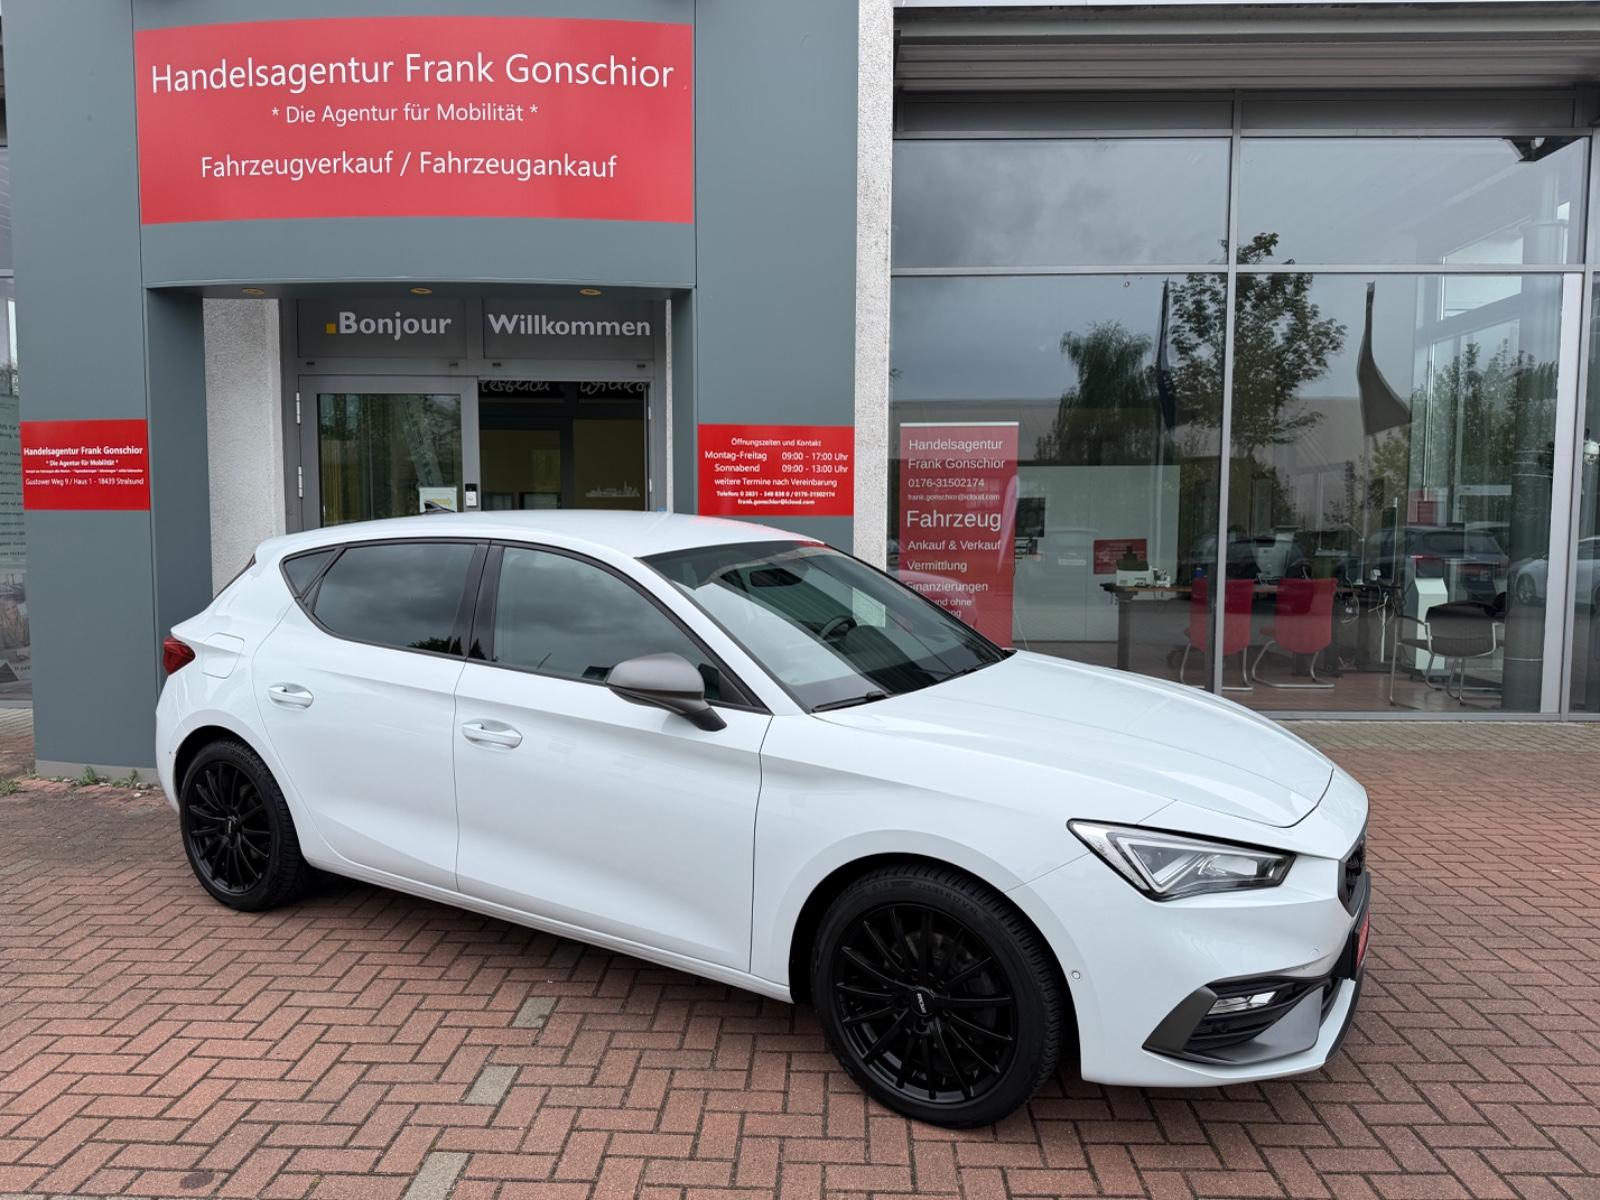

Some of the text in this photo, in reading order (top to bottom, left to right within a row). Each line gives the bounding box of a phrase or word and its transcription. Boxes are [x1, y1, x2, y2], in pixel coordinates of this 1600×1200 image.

[152, 52, 674, 94] Handelsagentur Frank Gonschior
[287, 104, 315, 123] Die
[321, 104, 397, 127] Agentur
[403, 102, 430, 122] für
[437, 103, 523, 122] Mobilität
[201, 151, 616, 181] Fahrzeugverkauf / Fahrzeugankauf
[339, 311, 651, 341] Bonjour Willkommen
[731, 437, 821, 448] Öffnungszeiten und Kontakt
[908, 439, 1004, 452] Handelsagentur
[24, 447, 79, 457] Handelsagentur
[81, 446, 101, 455] Frank
[103, 445, 143, 455] Gonschior
[704, 450, 767, 461] Montag-Freitag
[782, 452, 803, 460] 09:00
[812, 452, 833, 460] 17:00
[834, 452, 849, 461] Uhr
[714, 463, 760, 472] Sonnabend
[782, 465, 803, 473] 09:00
[812, 465, 833, 473] 13:00
[834, 465, 849, 473] Uhr
[908, 457, 1005, 469] Frank Gonschior
[51, 478, 64, 487] Weg
[714, 478, 837, 488] weitere Termine nach Vereinbarung
[908, 478, 985, 488] 0176-31502174
[906, 509, 1001, 531] Fahrzeug
[908, 540, 1001, 550] Ankauf & Verkauf
[907, 560, 967, 572] Vermittlung
[950, 597, 972, 606] ohne
